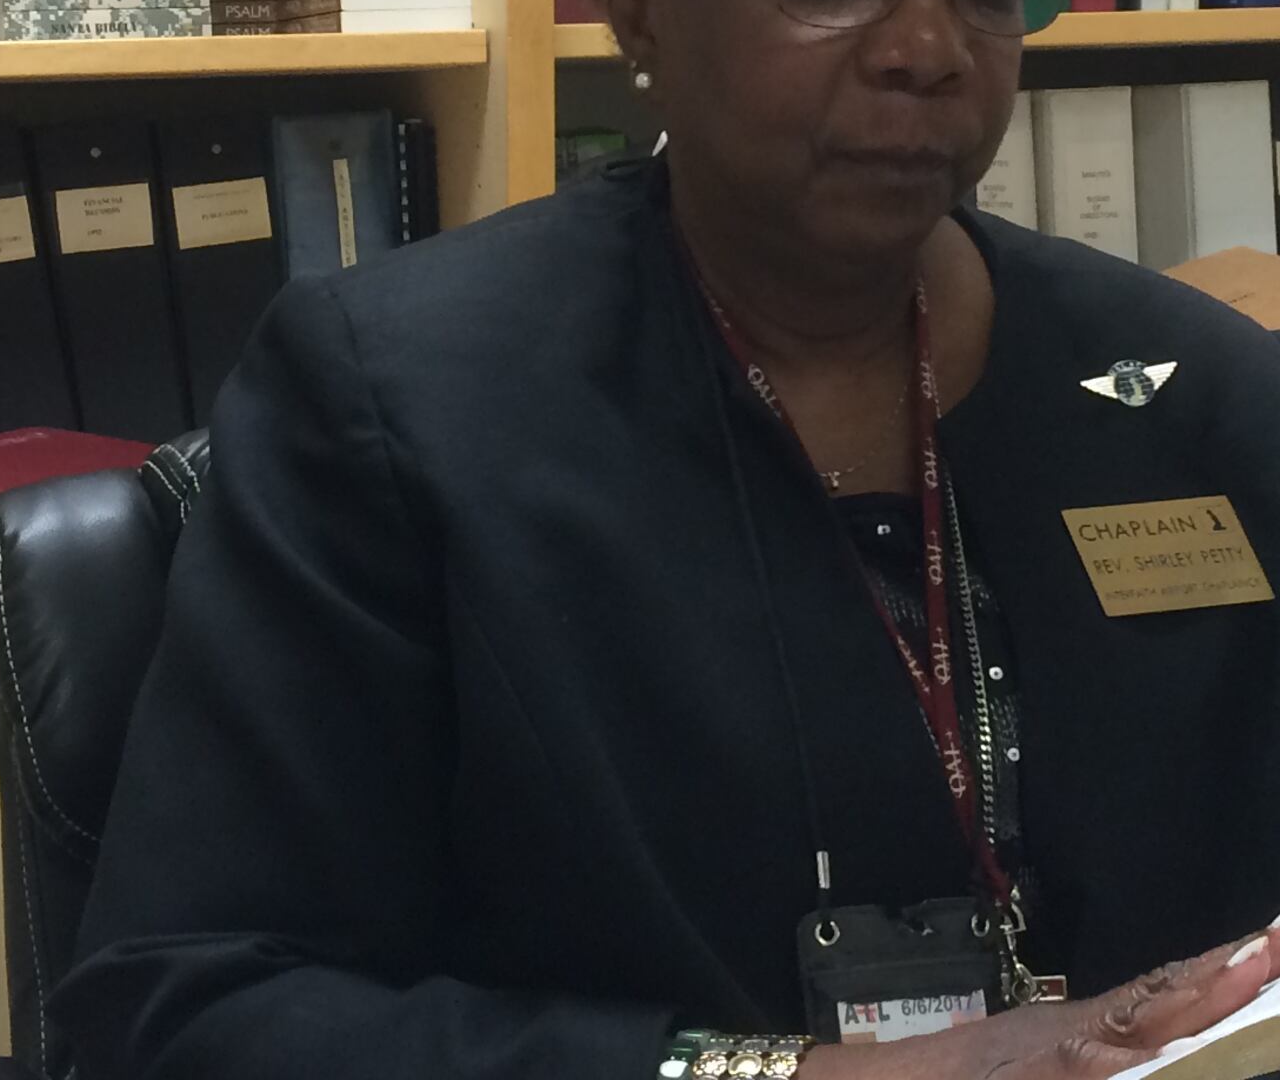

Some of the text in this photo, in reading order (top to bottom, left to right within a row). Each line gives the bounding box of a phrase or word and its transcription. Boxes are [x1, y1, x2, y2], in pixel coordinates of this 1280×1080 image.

[225, 5, 270, 18] PSALM
[51, 23, 137, 34] SANTA BIBLIA
[1078, 515, 1198, 542] CHAPLAIN
[1093, 546, 1245, 575] REV. SHIRLEY PETTY
[844, 995, 972, 1025] ATL 6/6/2017
